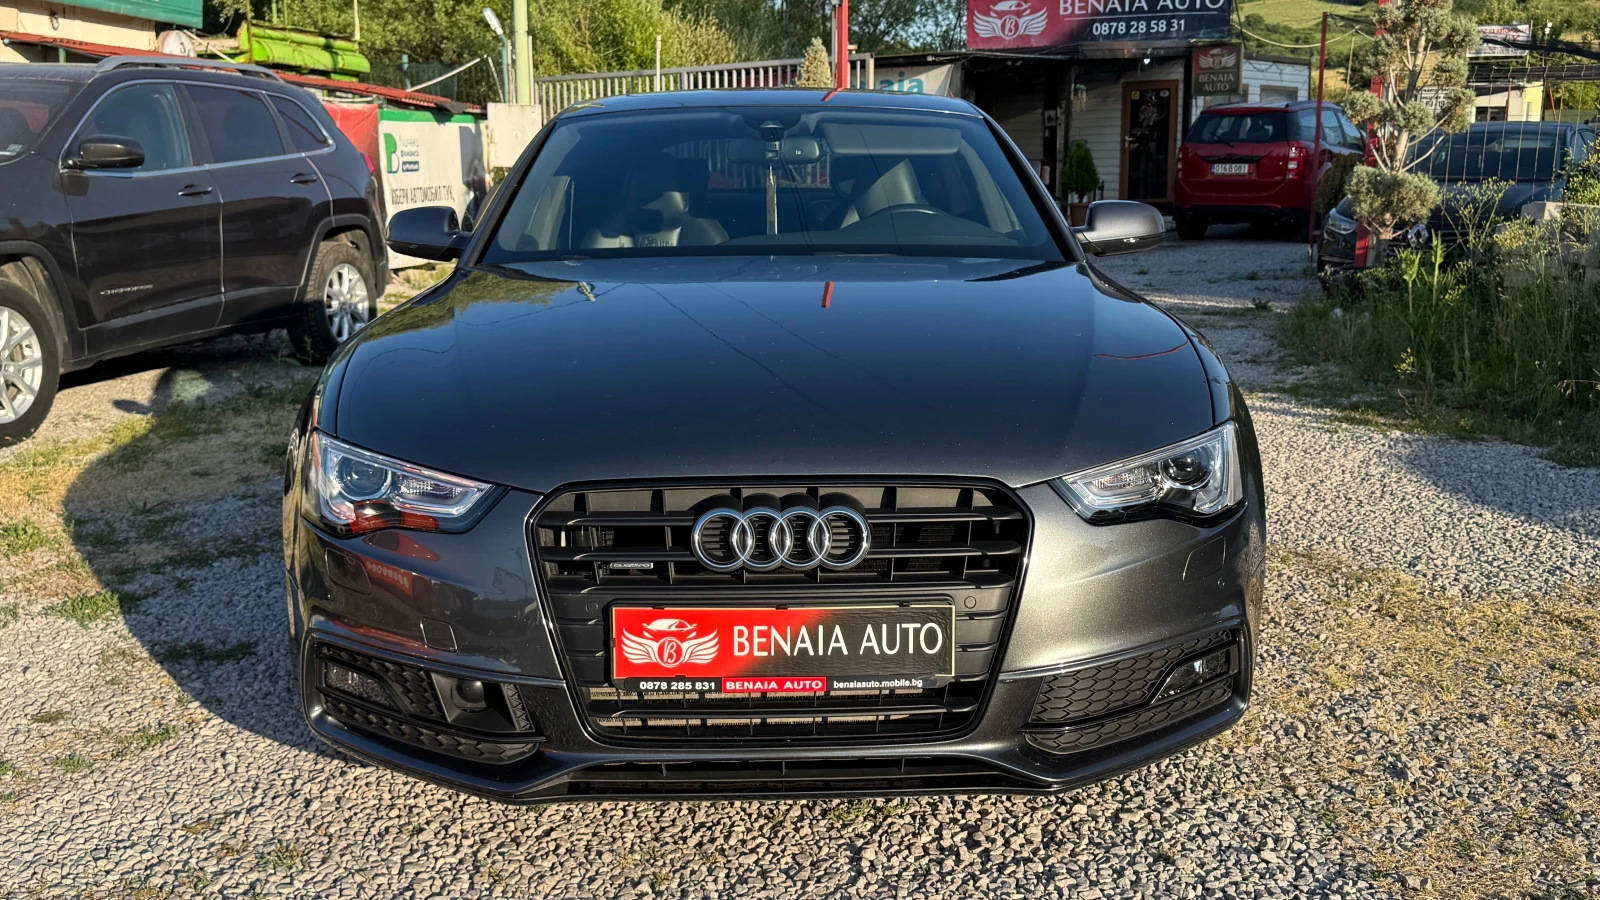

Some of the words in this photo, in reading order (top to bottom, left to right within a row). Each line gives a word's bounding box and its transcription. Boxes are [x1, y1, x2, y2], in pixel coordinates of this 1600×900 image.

[1059, 0, 1148, 15] BENAIA
[1092, 21, 1126, 35] 0878
[1129, 21, 1147, 34] 28
[1149, 20, 1166, 33] 58
[1169, 19, 1185, 32] 31
[1199, 73, 1234, 83] BENAIA
[1203, 82, 1229, 92] AUTO
[733, 624, 848, 657] BENAIA
[859, 622, 944, 656] AUTO
[639, 681, 669, 691] 0878
[670, 681, 693, 691] 285
[694, 681, 716, 691] 831
[726, 681, 777, 691] BENAIA
[784, 680, 823, 690] AUTO
[833, 678, 923, 689] benaiaauto.mobile.bg
